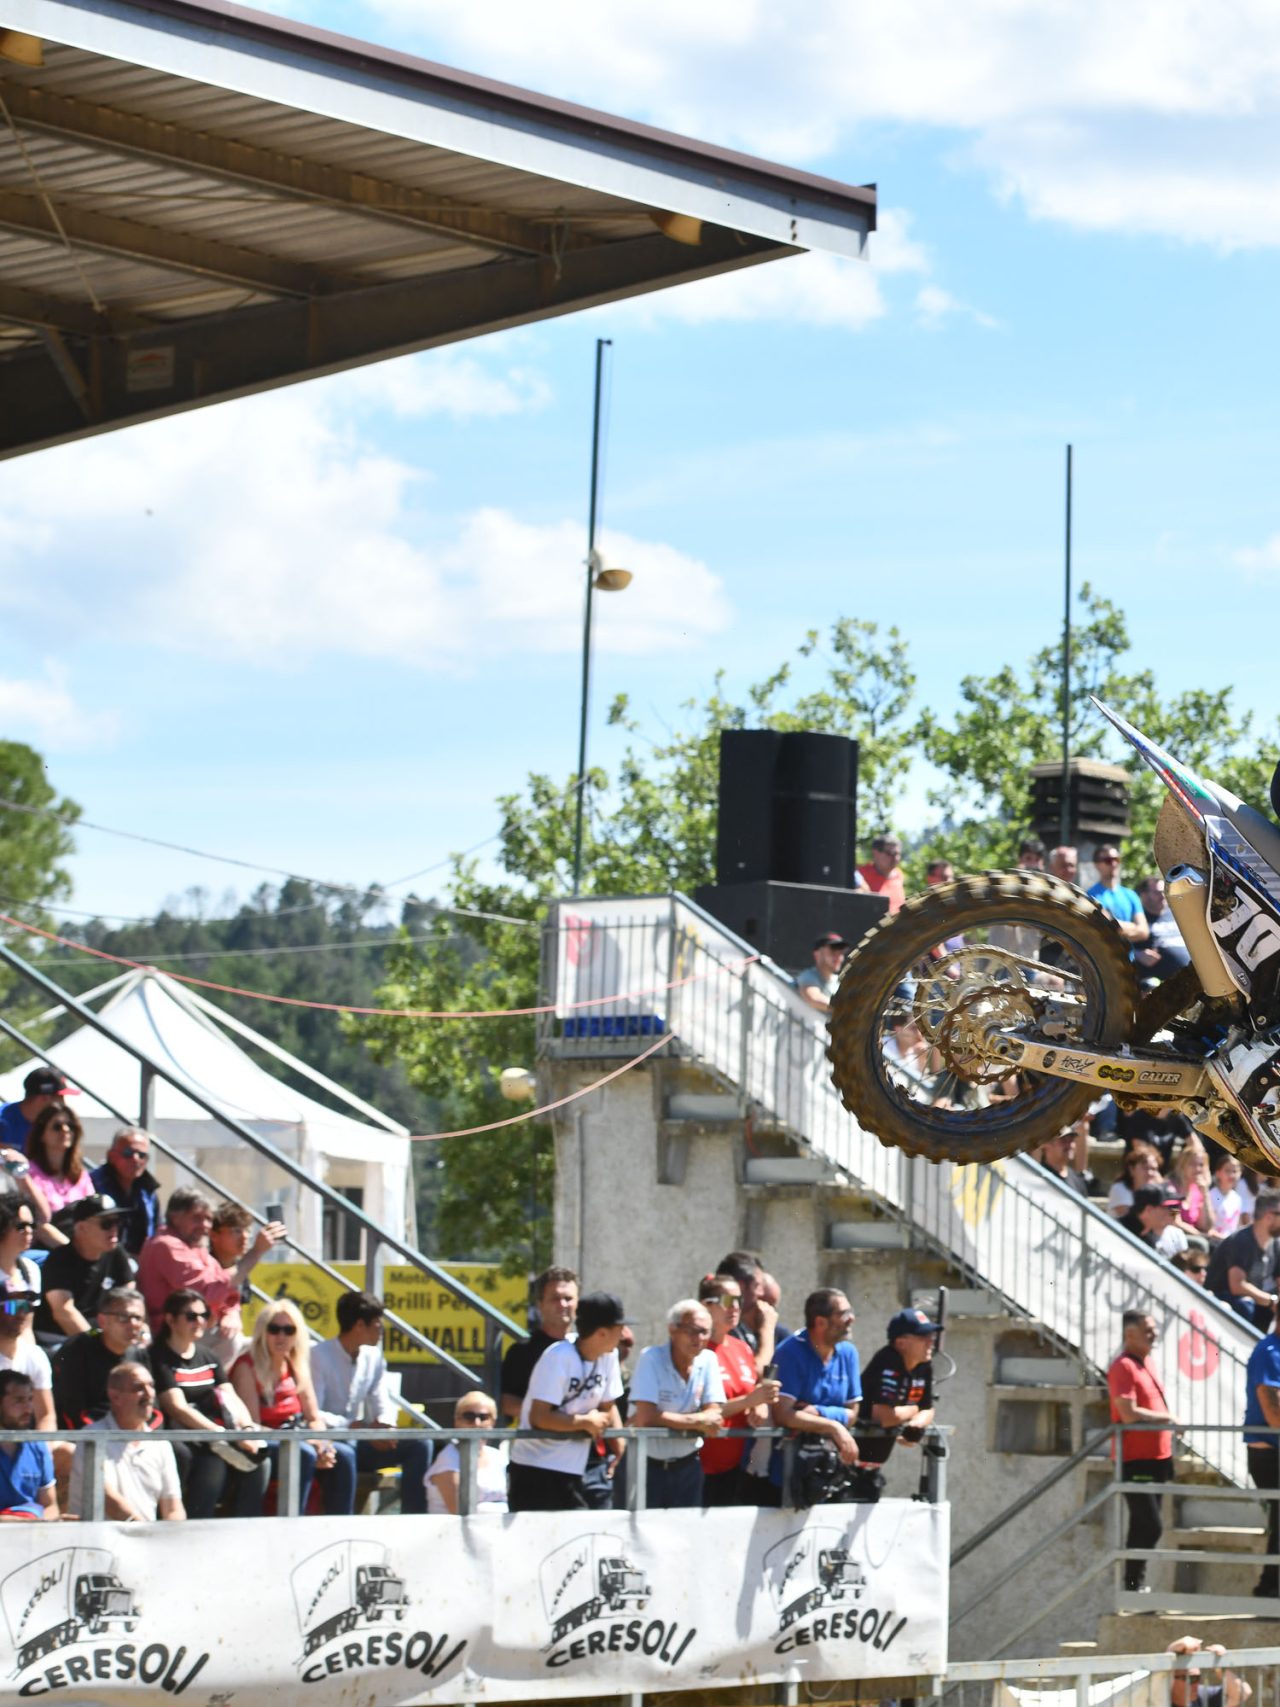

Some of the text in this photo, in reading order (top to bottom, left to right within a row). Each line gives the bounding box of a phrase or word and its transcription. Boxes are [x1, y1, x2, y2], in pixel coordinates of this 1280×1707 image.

[546, 1619, 697, 1668] CERESOLI
[774, 1608, 908, 1655] CERESOLI
[18, 1643, 210, 1697] CERESOLI
[301, 1631, 469, 1684] CERESOLI
